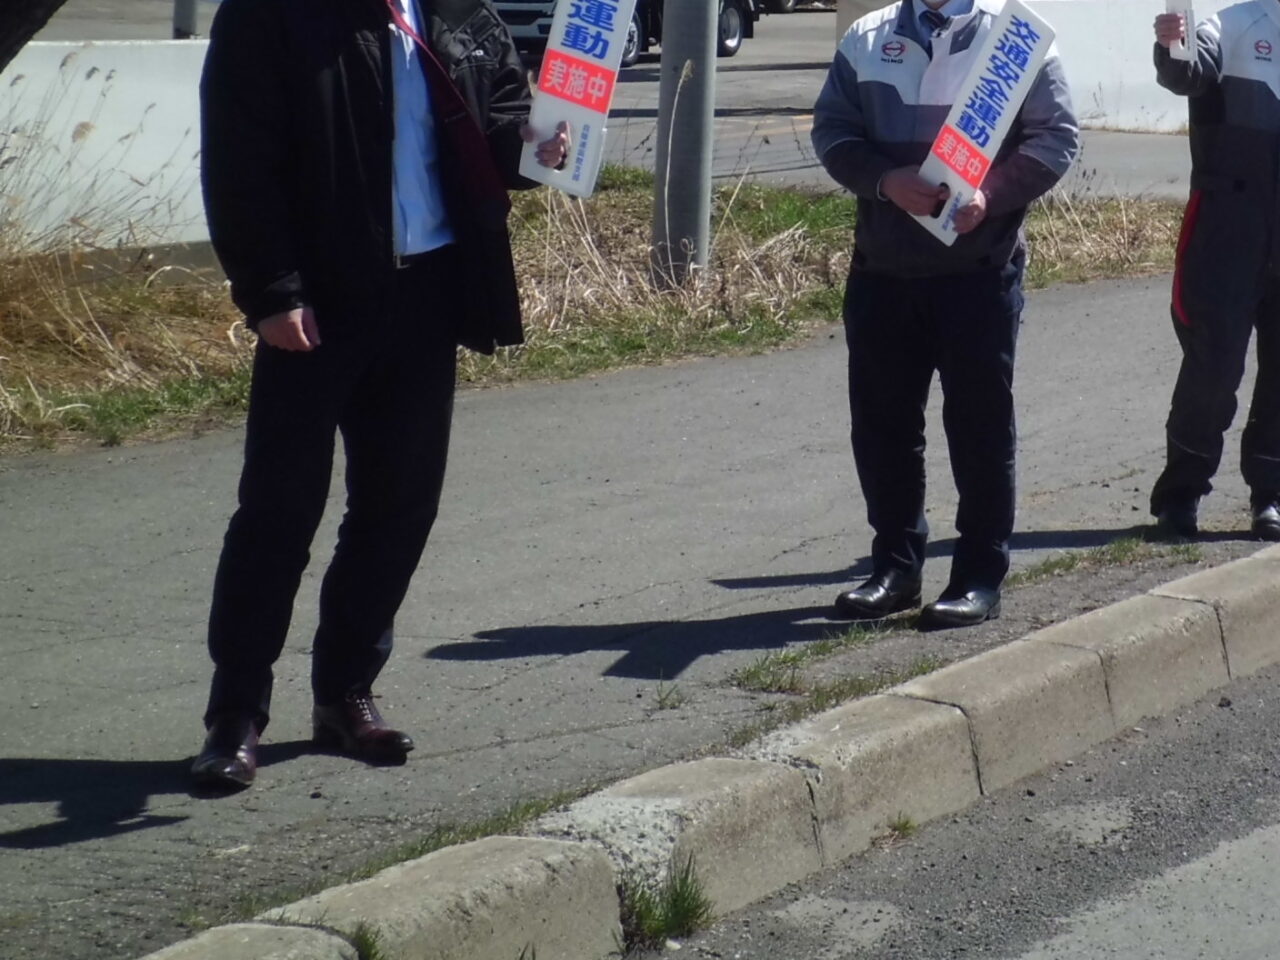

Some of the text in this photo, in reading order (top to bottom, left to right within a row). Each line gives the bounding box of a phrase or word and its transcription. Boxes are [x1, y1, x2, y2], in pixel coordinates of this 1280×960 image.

[547, 57, 608, 105] 実施中
[956, 14, 1040, 148] 交通安全運動
[936, 133, 983, 180] 実施中
